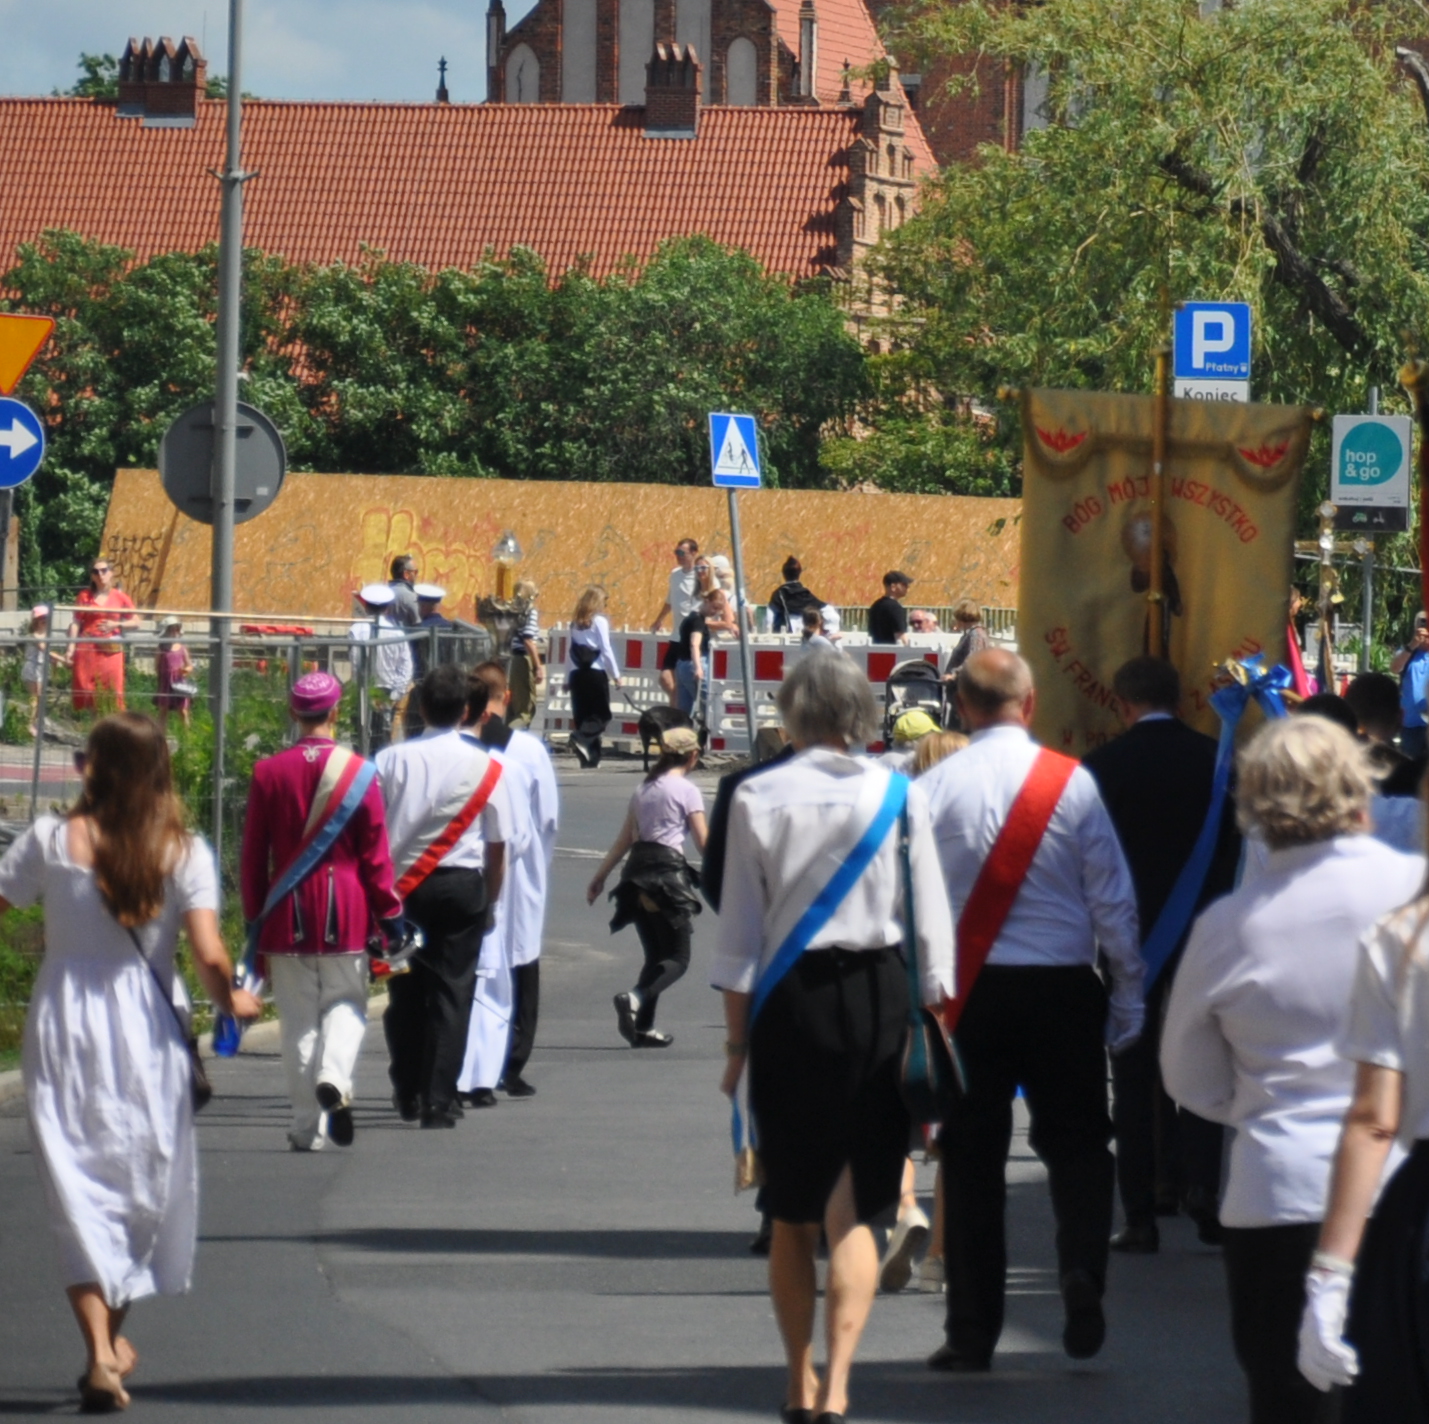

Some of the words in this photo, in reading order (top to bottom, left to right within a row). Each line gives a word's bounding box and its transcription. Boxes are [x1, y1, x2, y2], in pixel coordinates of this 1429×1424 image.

[1192, 310, 1235, 369] P
[1183, 386, 1239, 402] Koniec
[1345, 448, 1377, 466] hop
[1359, 465, 1381, 481] go
[1062, 495, 1103, 534] BÓG
[1170, 477, 1259, 544] WSZYSTKO
